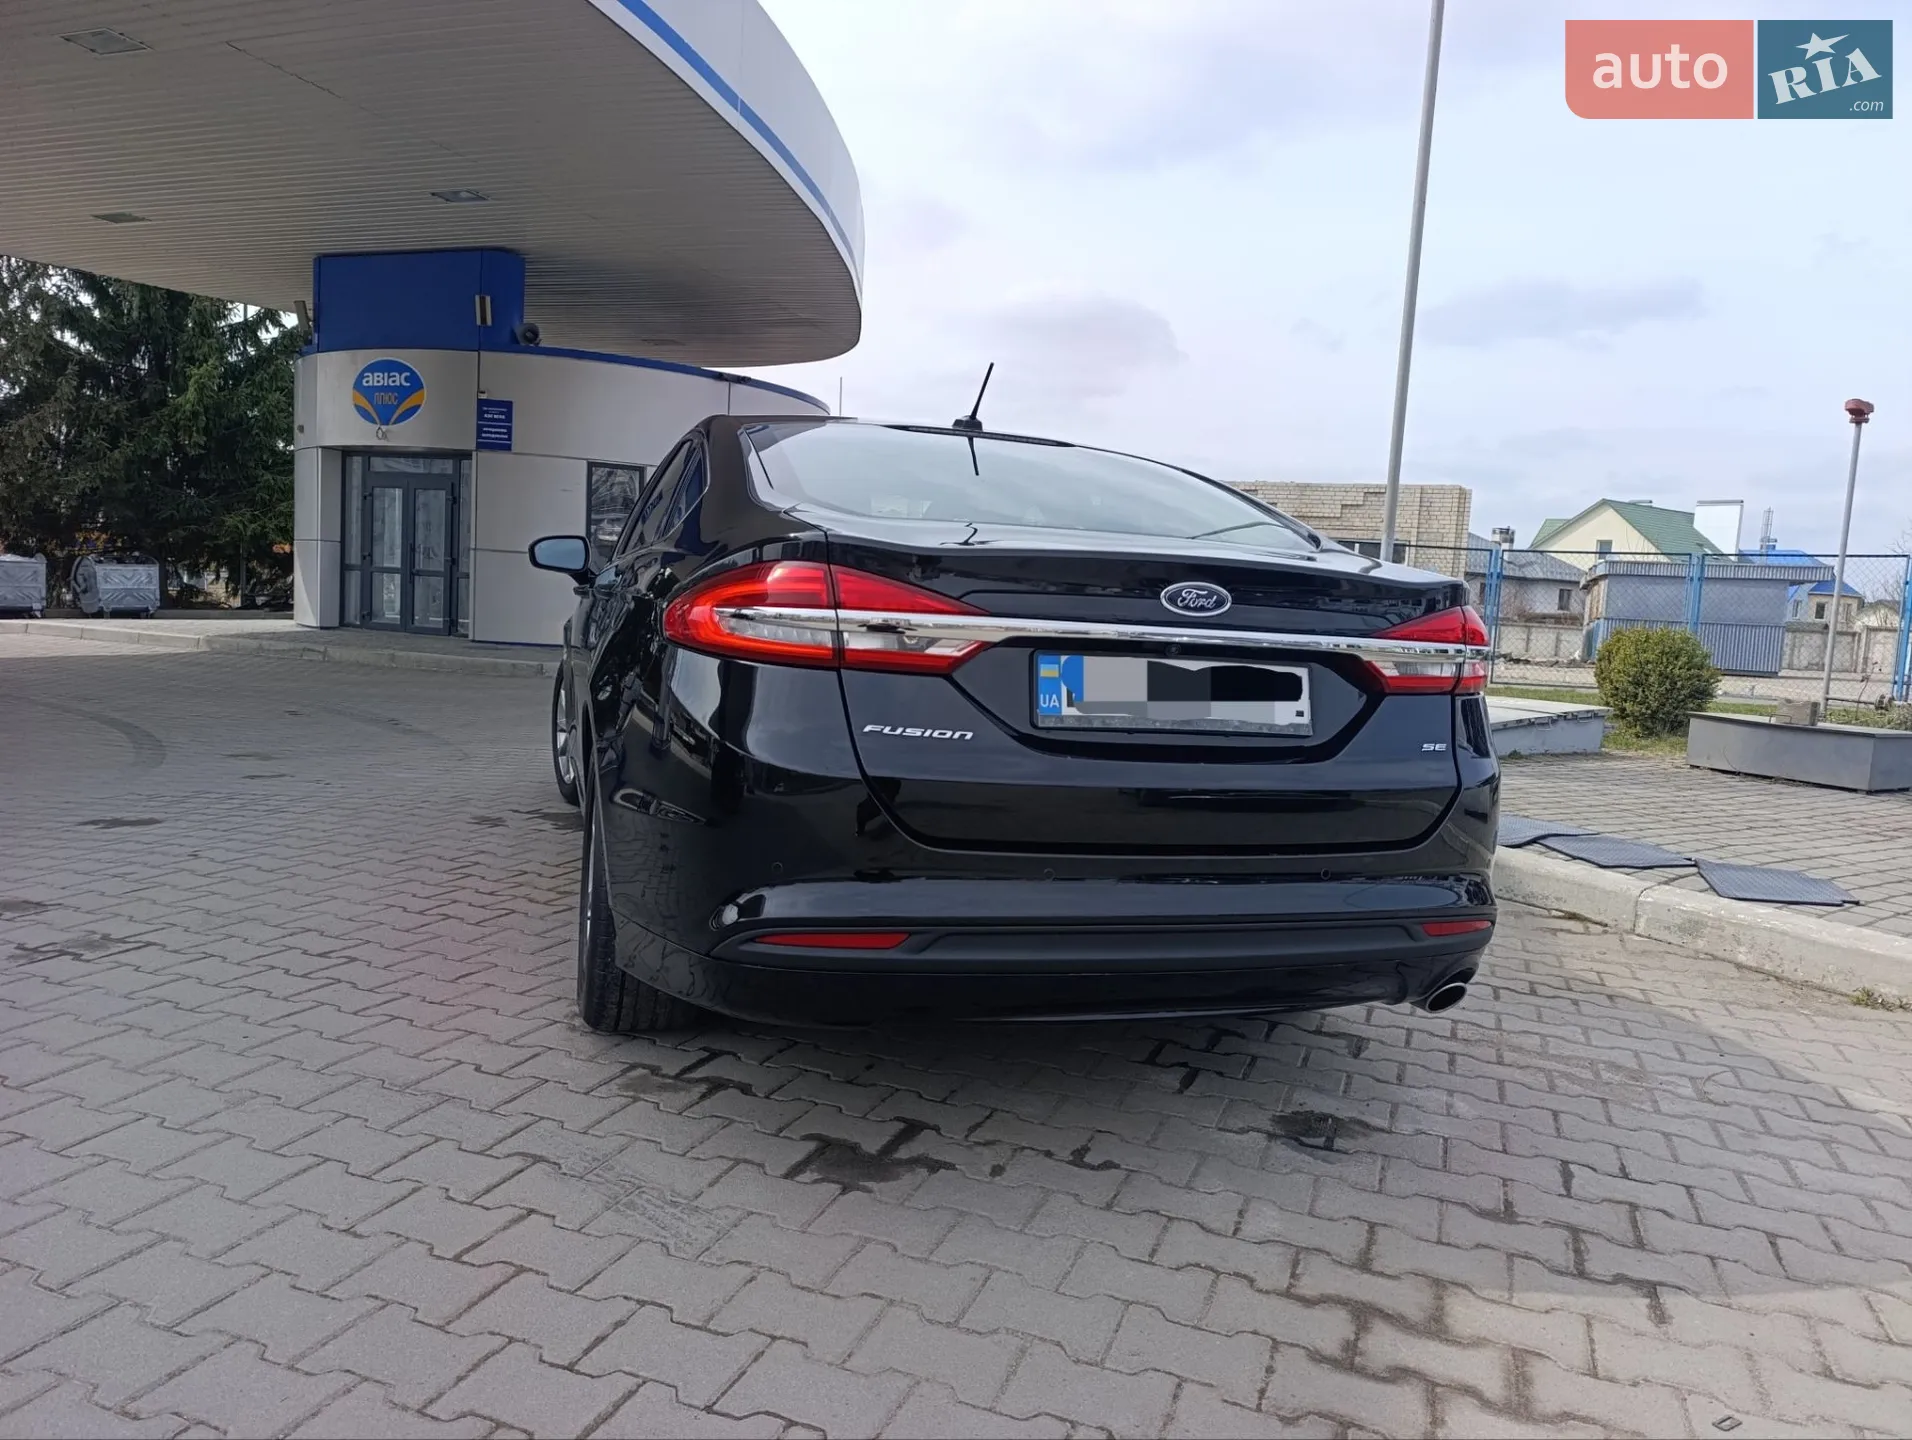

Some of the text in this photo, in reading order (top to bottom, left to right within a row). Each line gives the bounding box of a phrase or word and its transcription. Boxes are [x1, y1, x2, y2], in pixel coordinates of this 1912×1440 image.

[1177, 588, 1217, 608] Ford
[1040, 693, 1060, 708] UA
[862, 724, 974, 740] FUSION
[1421, 743, 1447, 751] SE
